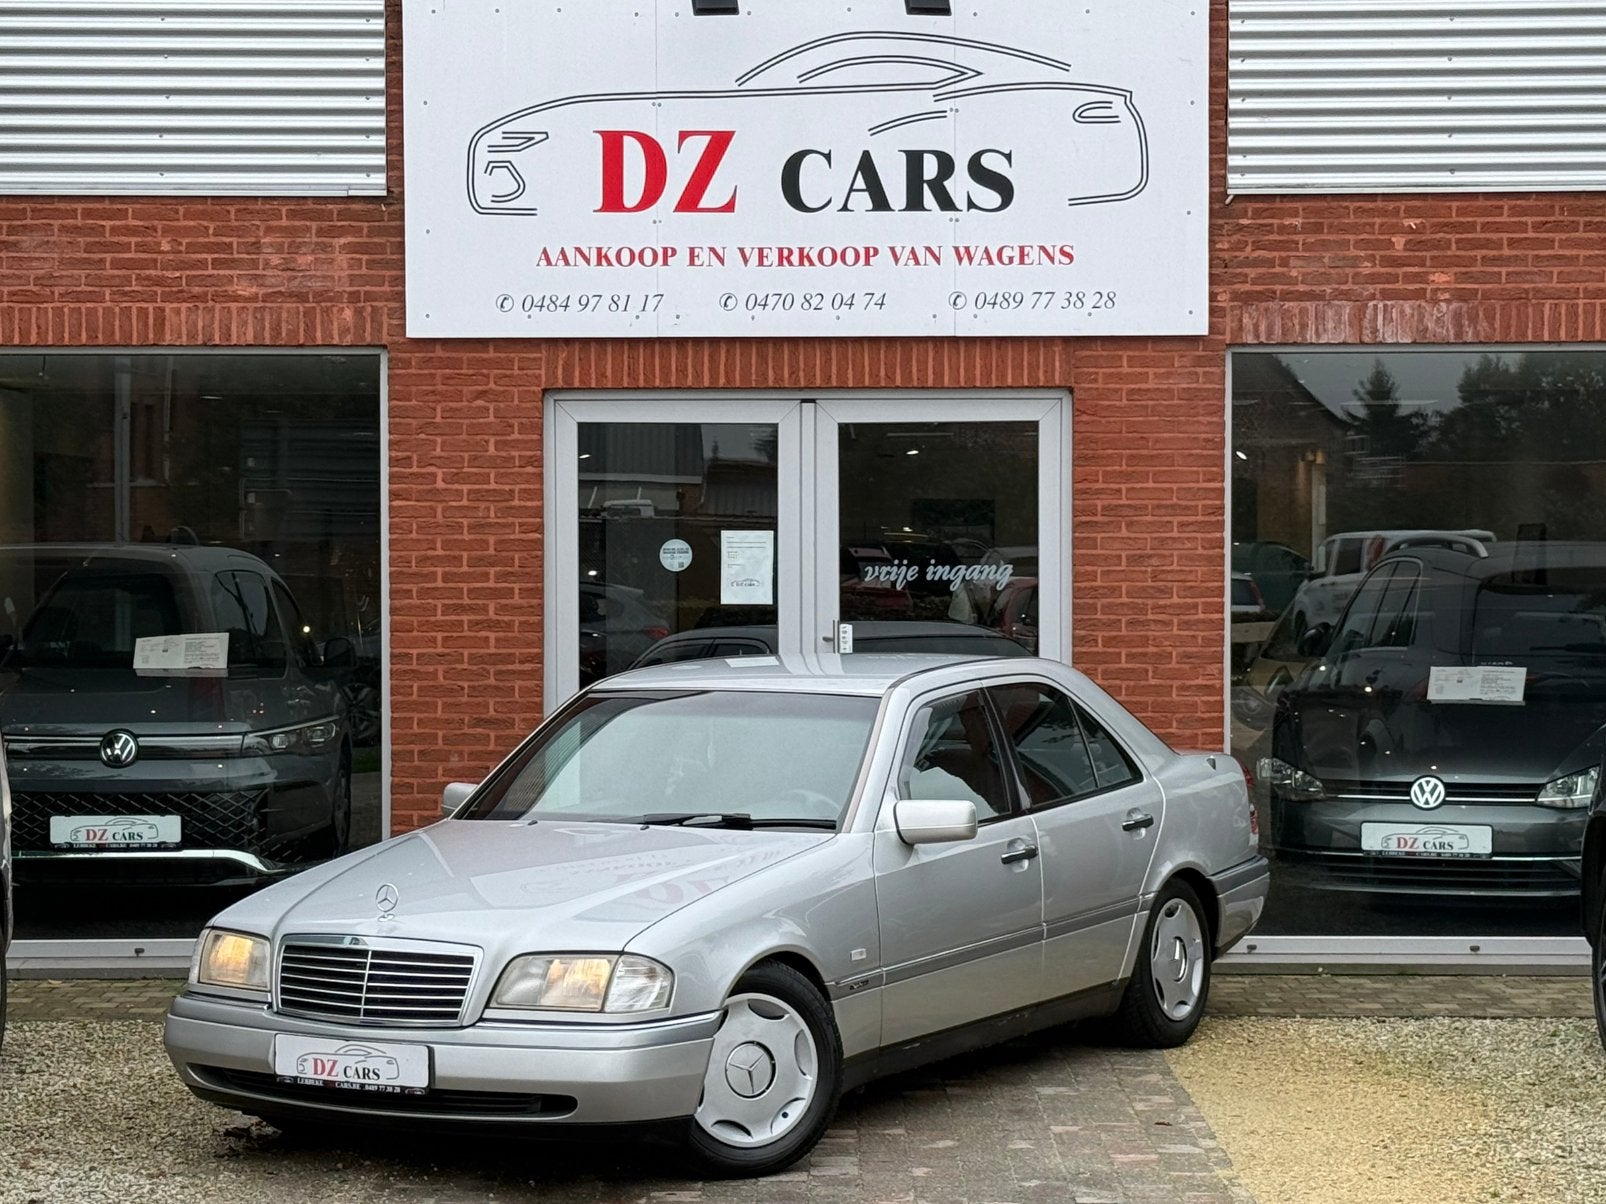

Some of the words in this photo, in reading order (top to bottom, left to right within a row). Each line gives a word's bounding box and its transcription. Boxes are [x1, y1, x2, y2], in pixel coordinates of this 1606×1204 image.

[593, 130, 738, 214] DZ
[780, 148, 1015, 214] CARS
[535, 246, 678, 268] AANKOOP
[687, 246, 727, 267] EN
[737, 246, 880, 268] VERKOOP
[888, 245, 943, 267] VAN
[952, 244, 1076, 266] WAGENS
[521, 294, 571, 313] 0484
[577, 294, 602, 313] 97
[608, 294, 632, 313] 81
[636, 294, 664, 313] 17
[745, 292, 795, 312] 0470
[800, 292, 825, 311] 82
[831, 292, 856, 311] 04
[863, 292, 887, 311] 74
[974, 291, 1024, 310] 0489
[1031, 291, 1056, 310] 77
[1061, 291, 1086, 310] 38
[1091, 291, 1117, 310] 28
[864, 559, 919, 591] vrije
[926, 559, 1013, 591] ingang
[84, 828, 109, 842] DZ
[112, 831, 144, 841] CARS
[1396, 836, 1419, 850] DZ
[1422, 840, 1455, 850] CARS
[312, 1057, 339, 1077] DZ
[343, 1065, 381, 1081] CARS
